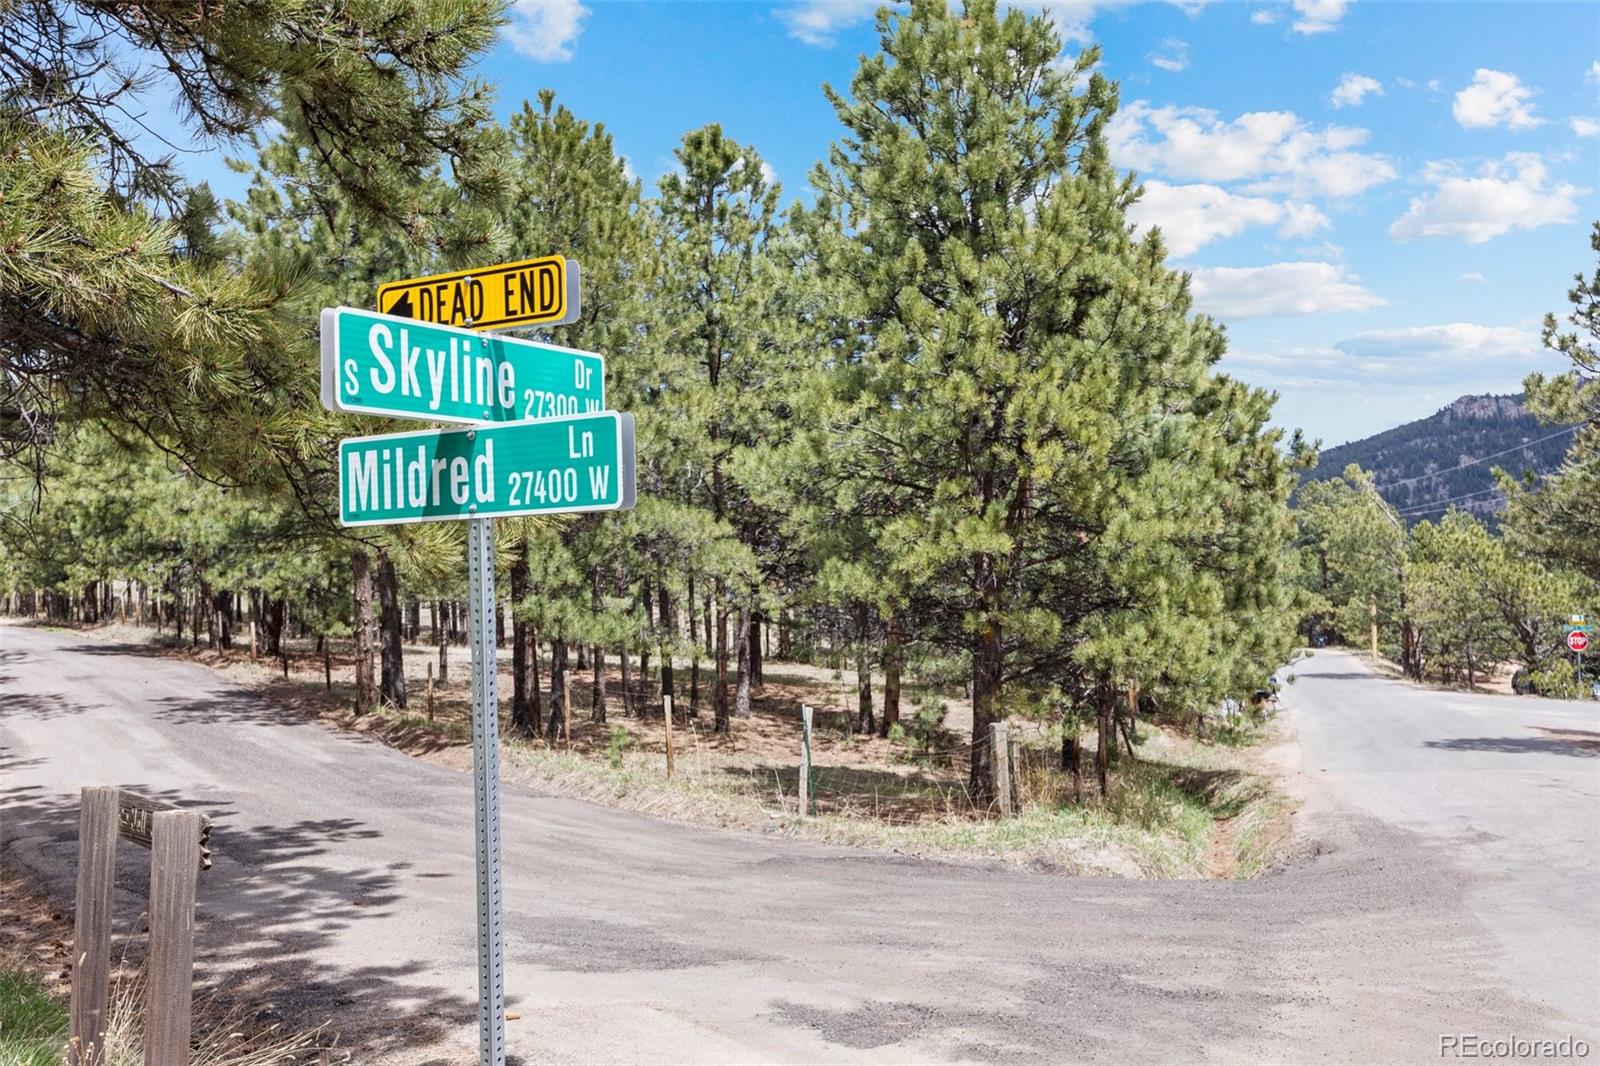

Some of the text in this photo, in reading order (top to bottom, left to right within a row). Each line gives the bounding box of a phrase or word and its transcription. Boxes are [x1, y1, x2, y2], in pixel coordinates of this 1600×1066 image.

[420, 268, 554, 325] DEAD END
[345, 323, 593, 411] S Skyline Dr
[524, 388, 578, 419] 27300
[348, 425, 594, 512] Mildred Ln
[508, 465, 610, 506] 27400 W
[1569, 636, 1587, 646] STOP
